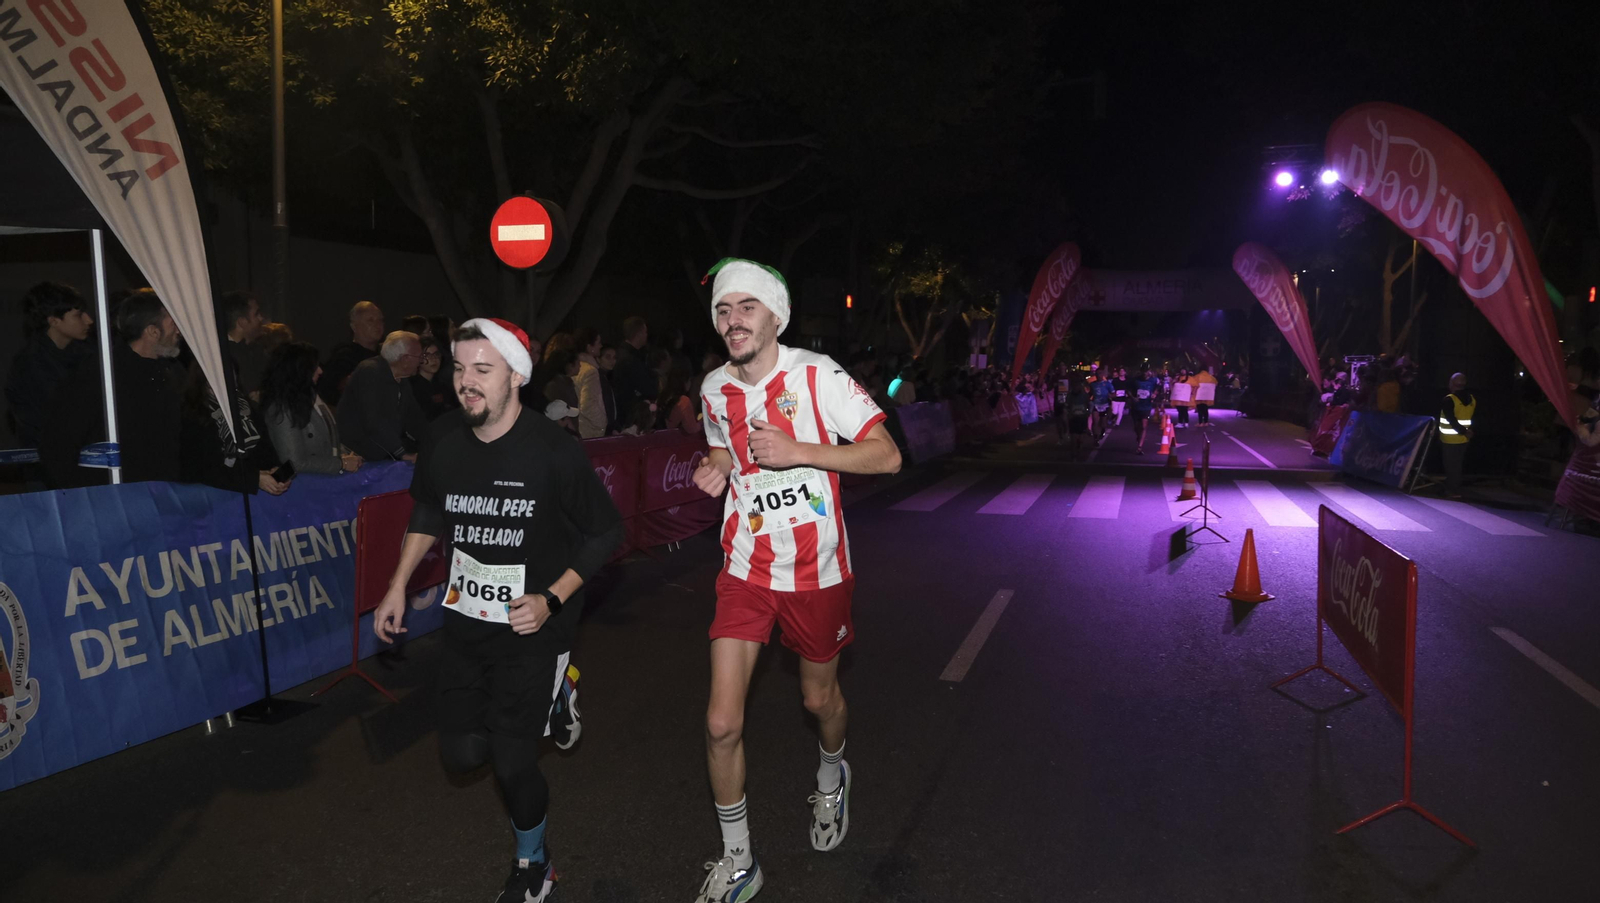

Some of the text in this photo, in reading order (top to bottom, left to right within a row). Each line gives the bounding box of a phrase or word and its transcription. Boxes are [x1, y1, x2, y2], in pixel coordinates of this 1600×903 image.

[1028, 249, 1077, 333] Coca-Cola
[663, 450, 708, 492] Coca-C
[445, 494, 536, 518] MEMORIAL PEPE
[753, 483, 811, 512] 1051
[454, 524, 524, 548] EL DE ELADIO
[457, 574, 513, 603] 1068
[1331, 538, 1382, 646] Coca-Cola
[9, 603, 20, 622] POR
[69, 618, 148, 681] DE
[163, 570, 334, 656] ALMERÍA
[16, 625, 24, 638] LA
[14, 641, 26, 687] LIBERTAD
